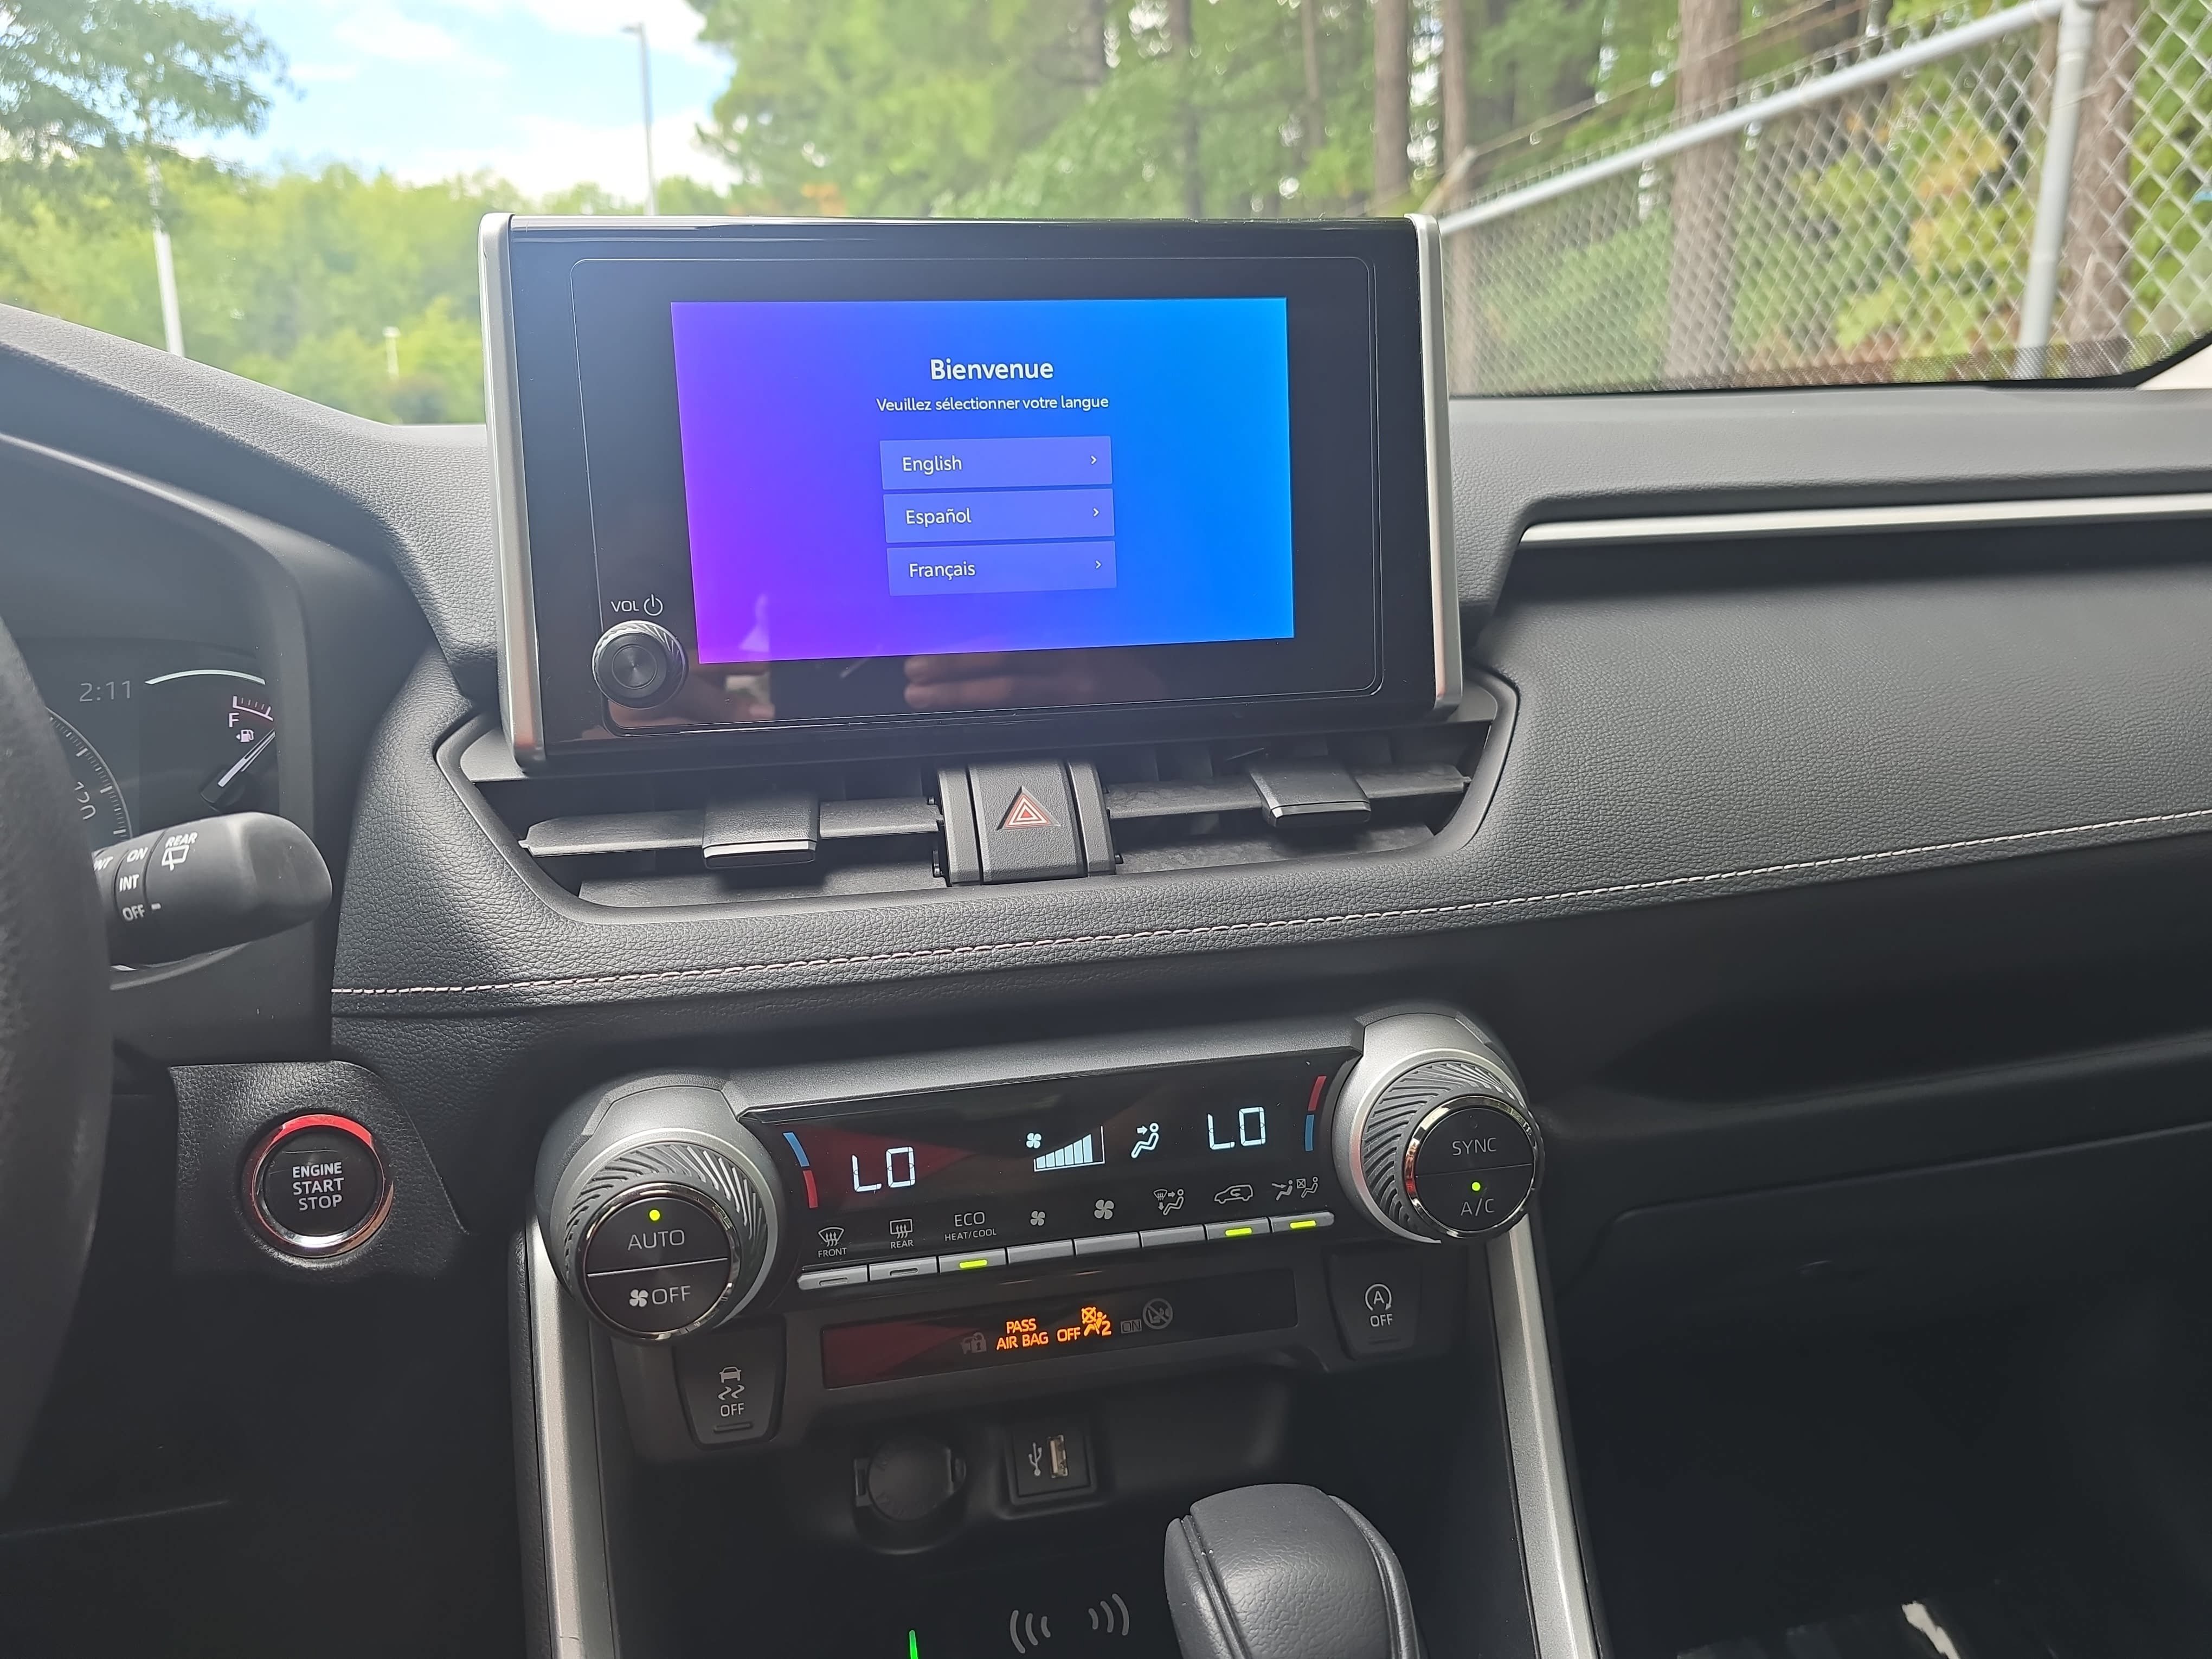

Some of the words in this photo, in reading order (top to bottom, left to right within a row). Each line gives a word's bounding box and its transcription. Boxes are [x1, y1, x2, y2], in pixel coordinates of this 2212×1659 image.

[930, 358, 1054, 380] Bienvenue
[876, 397, 932, 411] Veuillez
[935, 396, 1019, 410] sélectionner
[1023, 397, 1057, 409] votre
[1061, 395, 1109, 411] langue
[902, 455, 963, 475] English
[906, 507, 972, 528] Español
[909, 561, 976, 580] Français
[610, 600, 640, 612] VOL
[79, 680, 131, 702] 2:11
[228, 713, 239, 728] F
[165, 832, 198, 848] REAR
[126, 847, 148, 863] ON
[119, 874, 139, 892] INT
[122, 904, 145, 921] OFF
[1207, 1107, 1266, 1150] LO
[1452, 1137, 1497, 1156] SYNC
[292, 1162, 343, 1179] ENGINE
[852, 1146, 916, 1192] LO
[293, 1178, 344, 1195] START
[299, 1194, 343, 1211] STOP
[1460, 1198, 1495, 1216] A/C
[954, 1211, 985, 1227] ECO
[627, 1230, 685, 1251] AUTO
[944, 1228, 997, 1242] HEAT/COOL
[890, 1239, 914, 1249] REAR
[818, 1248, 847, 1258] FRONT
[652, 1285, 691, 1304] OFF
[1006, 1318, 1037, 1334] PASS
[1370, 1314, 1393, 1327] OFF
[996, 1335, 1019, 1351] AIR
[1021, 1332, 1049, 1348] BAG
[1057, 1327, 1081, 1342] OFF
[720, 1403, 744, 1417] OFF
